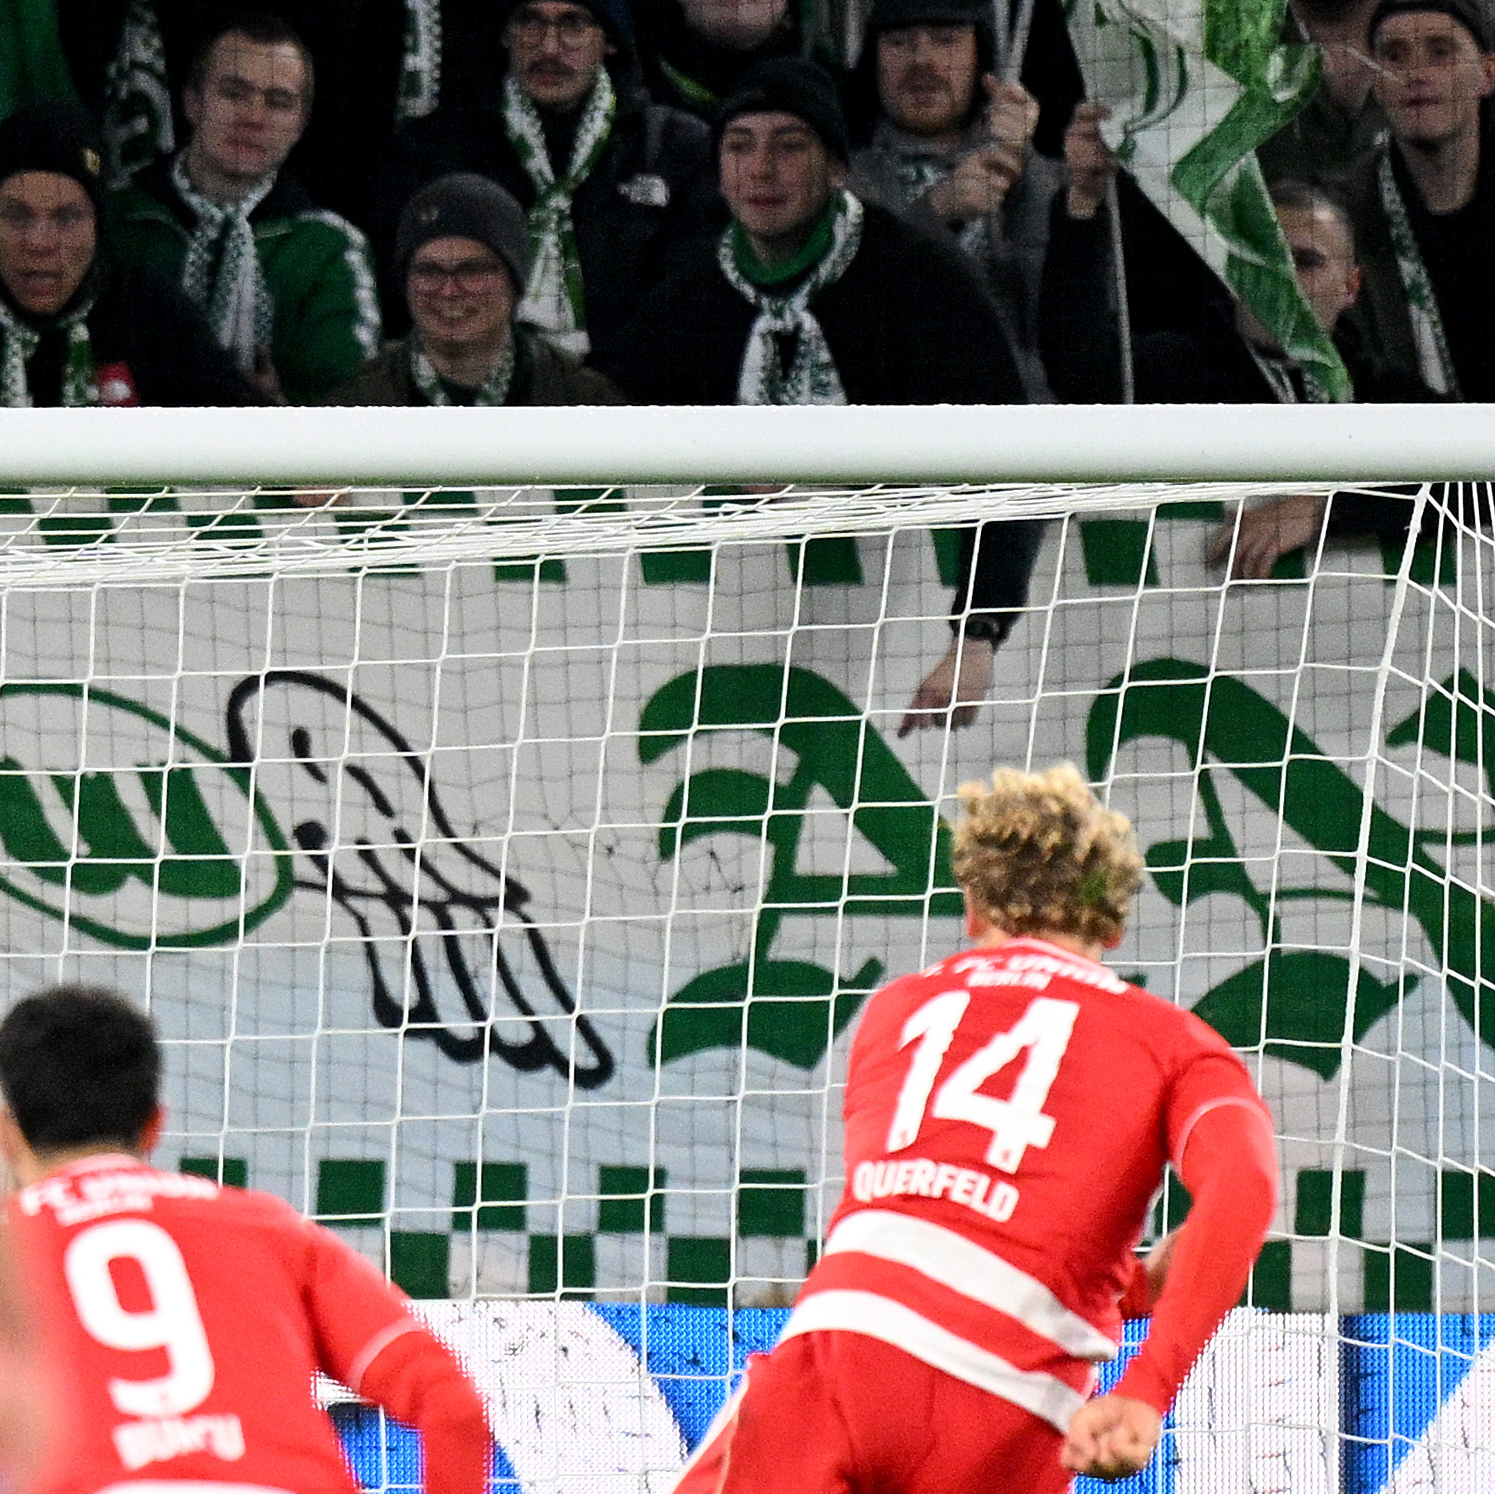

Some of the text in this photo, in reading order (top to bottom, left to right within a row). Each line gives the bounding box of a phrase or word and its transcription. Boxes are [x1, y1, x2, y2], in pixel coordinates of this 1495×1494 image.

[887, 989, 1081, 1175] 14
[853, 1158, 1020, 1223] QUERFELD
[65, 1218, 216, 1416] 9
